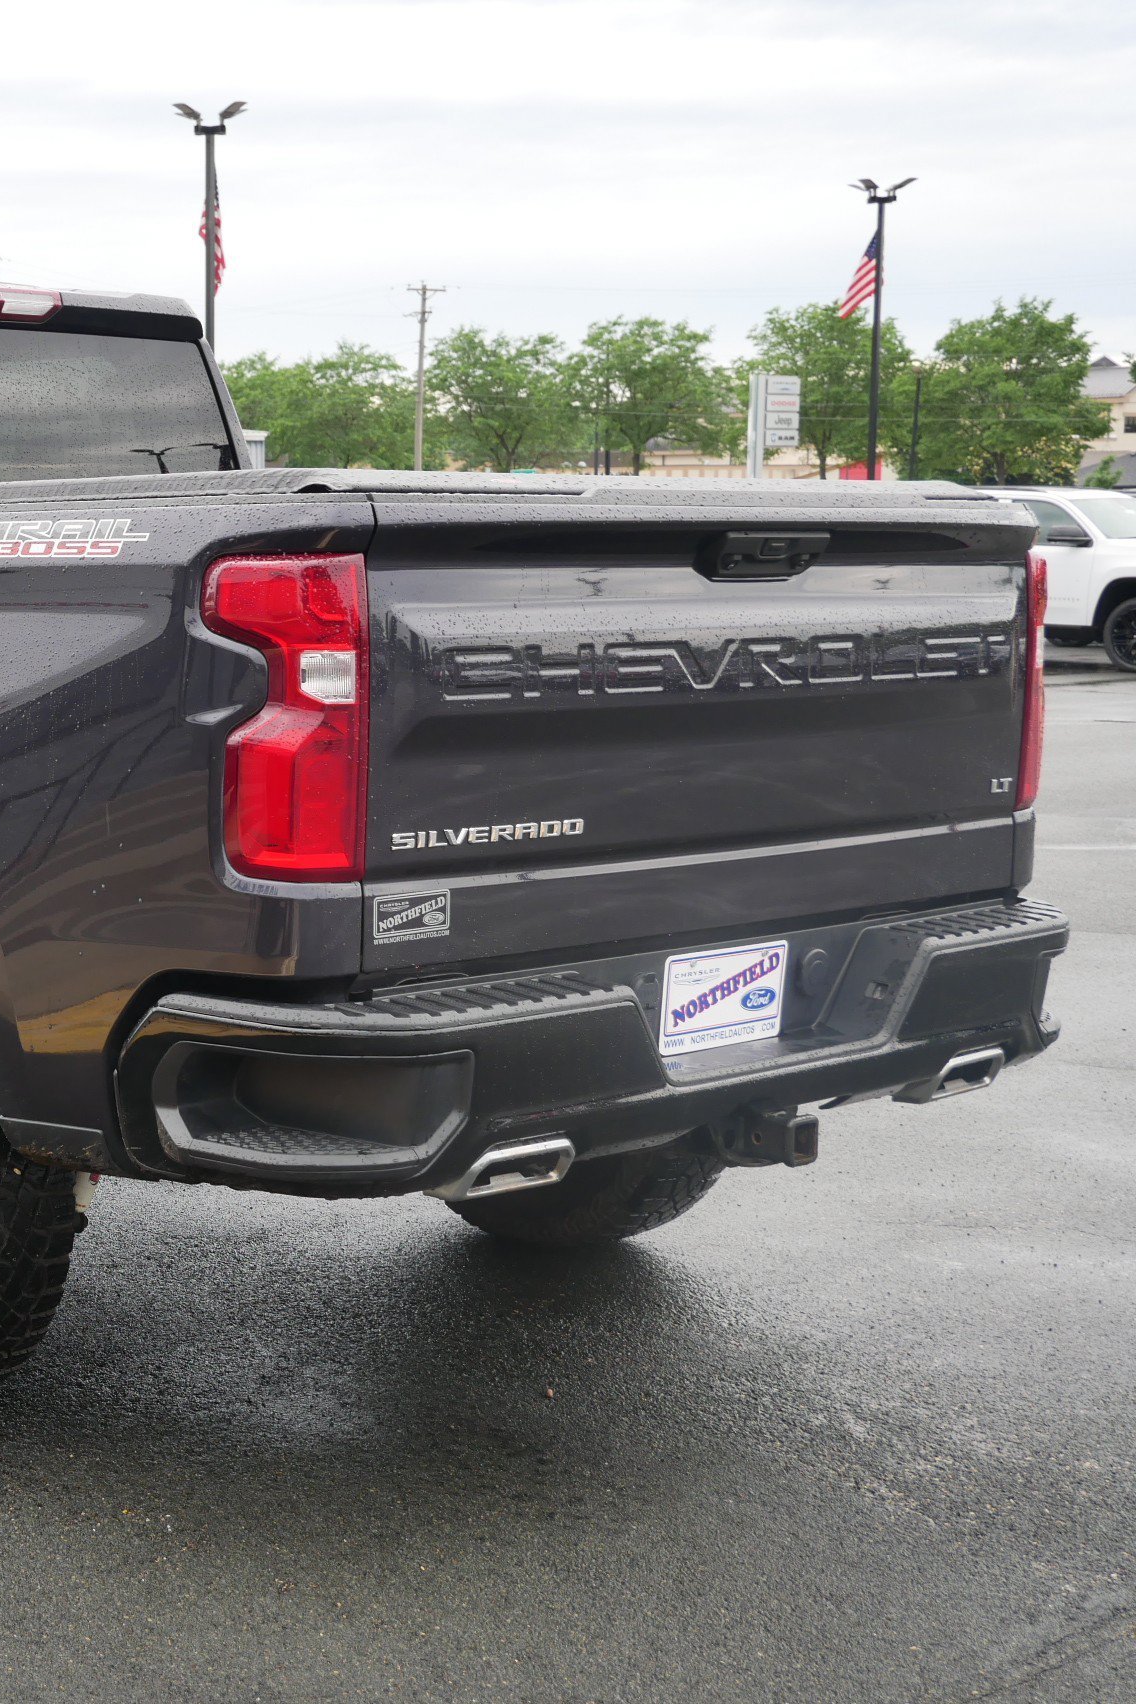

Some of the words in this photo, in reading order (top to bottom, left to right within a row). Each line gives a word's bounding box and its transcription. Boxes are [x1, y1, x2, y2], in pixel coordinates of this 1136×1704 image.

[774, 414, 793, 427] Jeep
[442, 632, 1007, 701] CHEVROLET
[990, 777, 1013, 794] LT
[391, 818, 584, 850] SILVERADO
[378, 896, 446, 932] NORTHFIELD
[674, 967, 720, 979] CHRYSLER
[670, 951, 781, 1028] NORTHFIELD
[747, 990, 772, 1007] Ford
[690, 1025, 755, 1045] NORTHFIELDAUTOS
